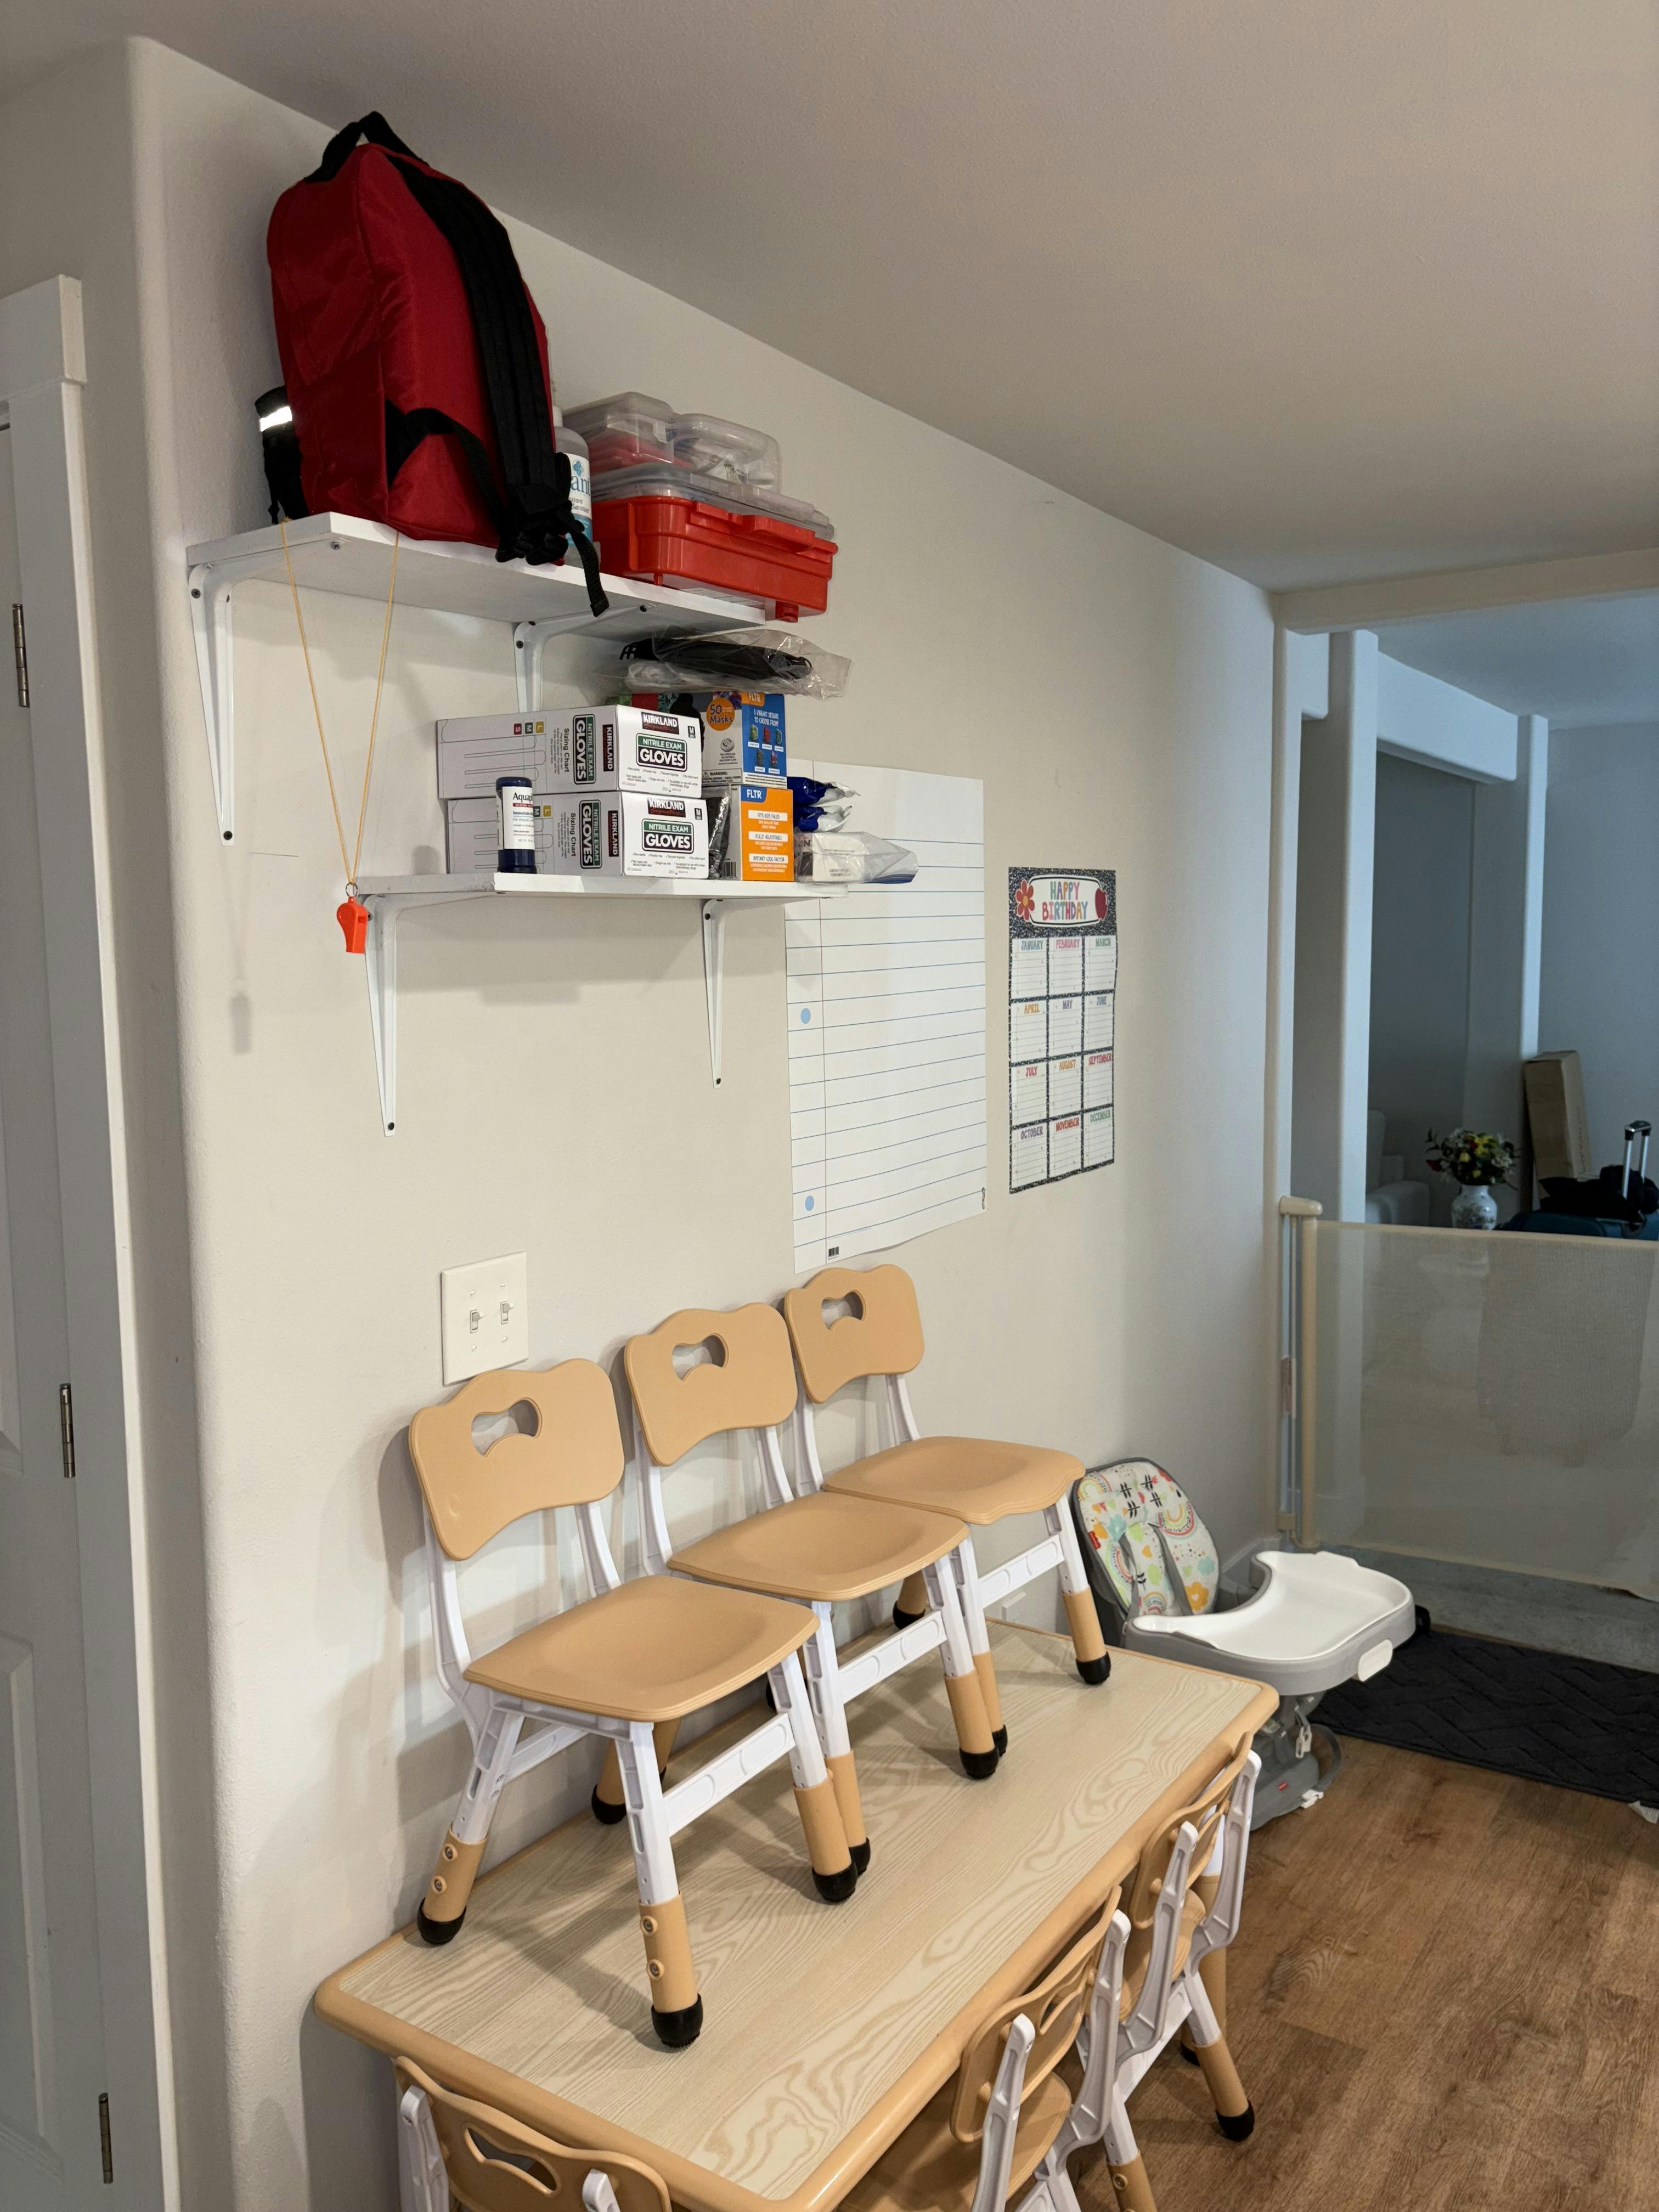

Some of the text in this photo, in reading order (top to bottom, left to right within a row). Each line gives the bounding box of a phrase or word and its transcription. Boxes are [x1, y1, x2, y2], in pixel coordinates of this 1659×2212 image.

[571, 475, 590, 496] ant
[568, 496, 583, 504] stant
[748, 693, 761, 702] FLTR
[710, 704, 722, 715] 50
[643, 714, 678, 727] KIRKLAND
[710, 715, 732, 724] Masks
[576, 720, 586, 780] GLOVES
[643, 738, 682, 750] NITRILE EXAM
[640, 748, 684, 766] GLOVES
[513, 792, 533, 803] Aquap
[747, 789, 762, 799] FLTR
[650, 798, 684, 810] KIRKLAND
[648, 823, 671, 832] NITRILE
[583, 805, 592, 864] GLOVES
[646, 833, 690, 849] GLOVES
[1050, 881, 1080, 900] HAPPY
[1042, 901, 1088, 921] BIRTHDAY
[1021, 940, 1043, 951] JANUARY
[1056, 939, 1080, 949] FEBRUARY
[1096, 938, 1111, 947] MARCH
[1062, 1000, 1073, 1010] MAY
[1097, 996, 1107, 1006] JUNE
[1024, 1003, 1040, 1014] APRIL
[1059, 1059, 1076, 1071] AUGUST
[1088, 1053, 1112, 1066] SEPTEMBER
[1025, 1066, 1038, 1077] JULY
[1090, 1109, 1111, 1124] DECEMBER
[1056, 1117, 1080, 1132] NOVEMBER
[1020, 1126, 1043, 1140] OCTOBER
